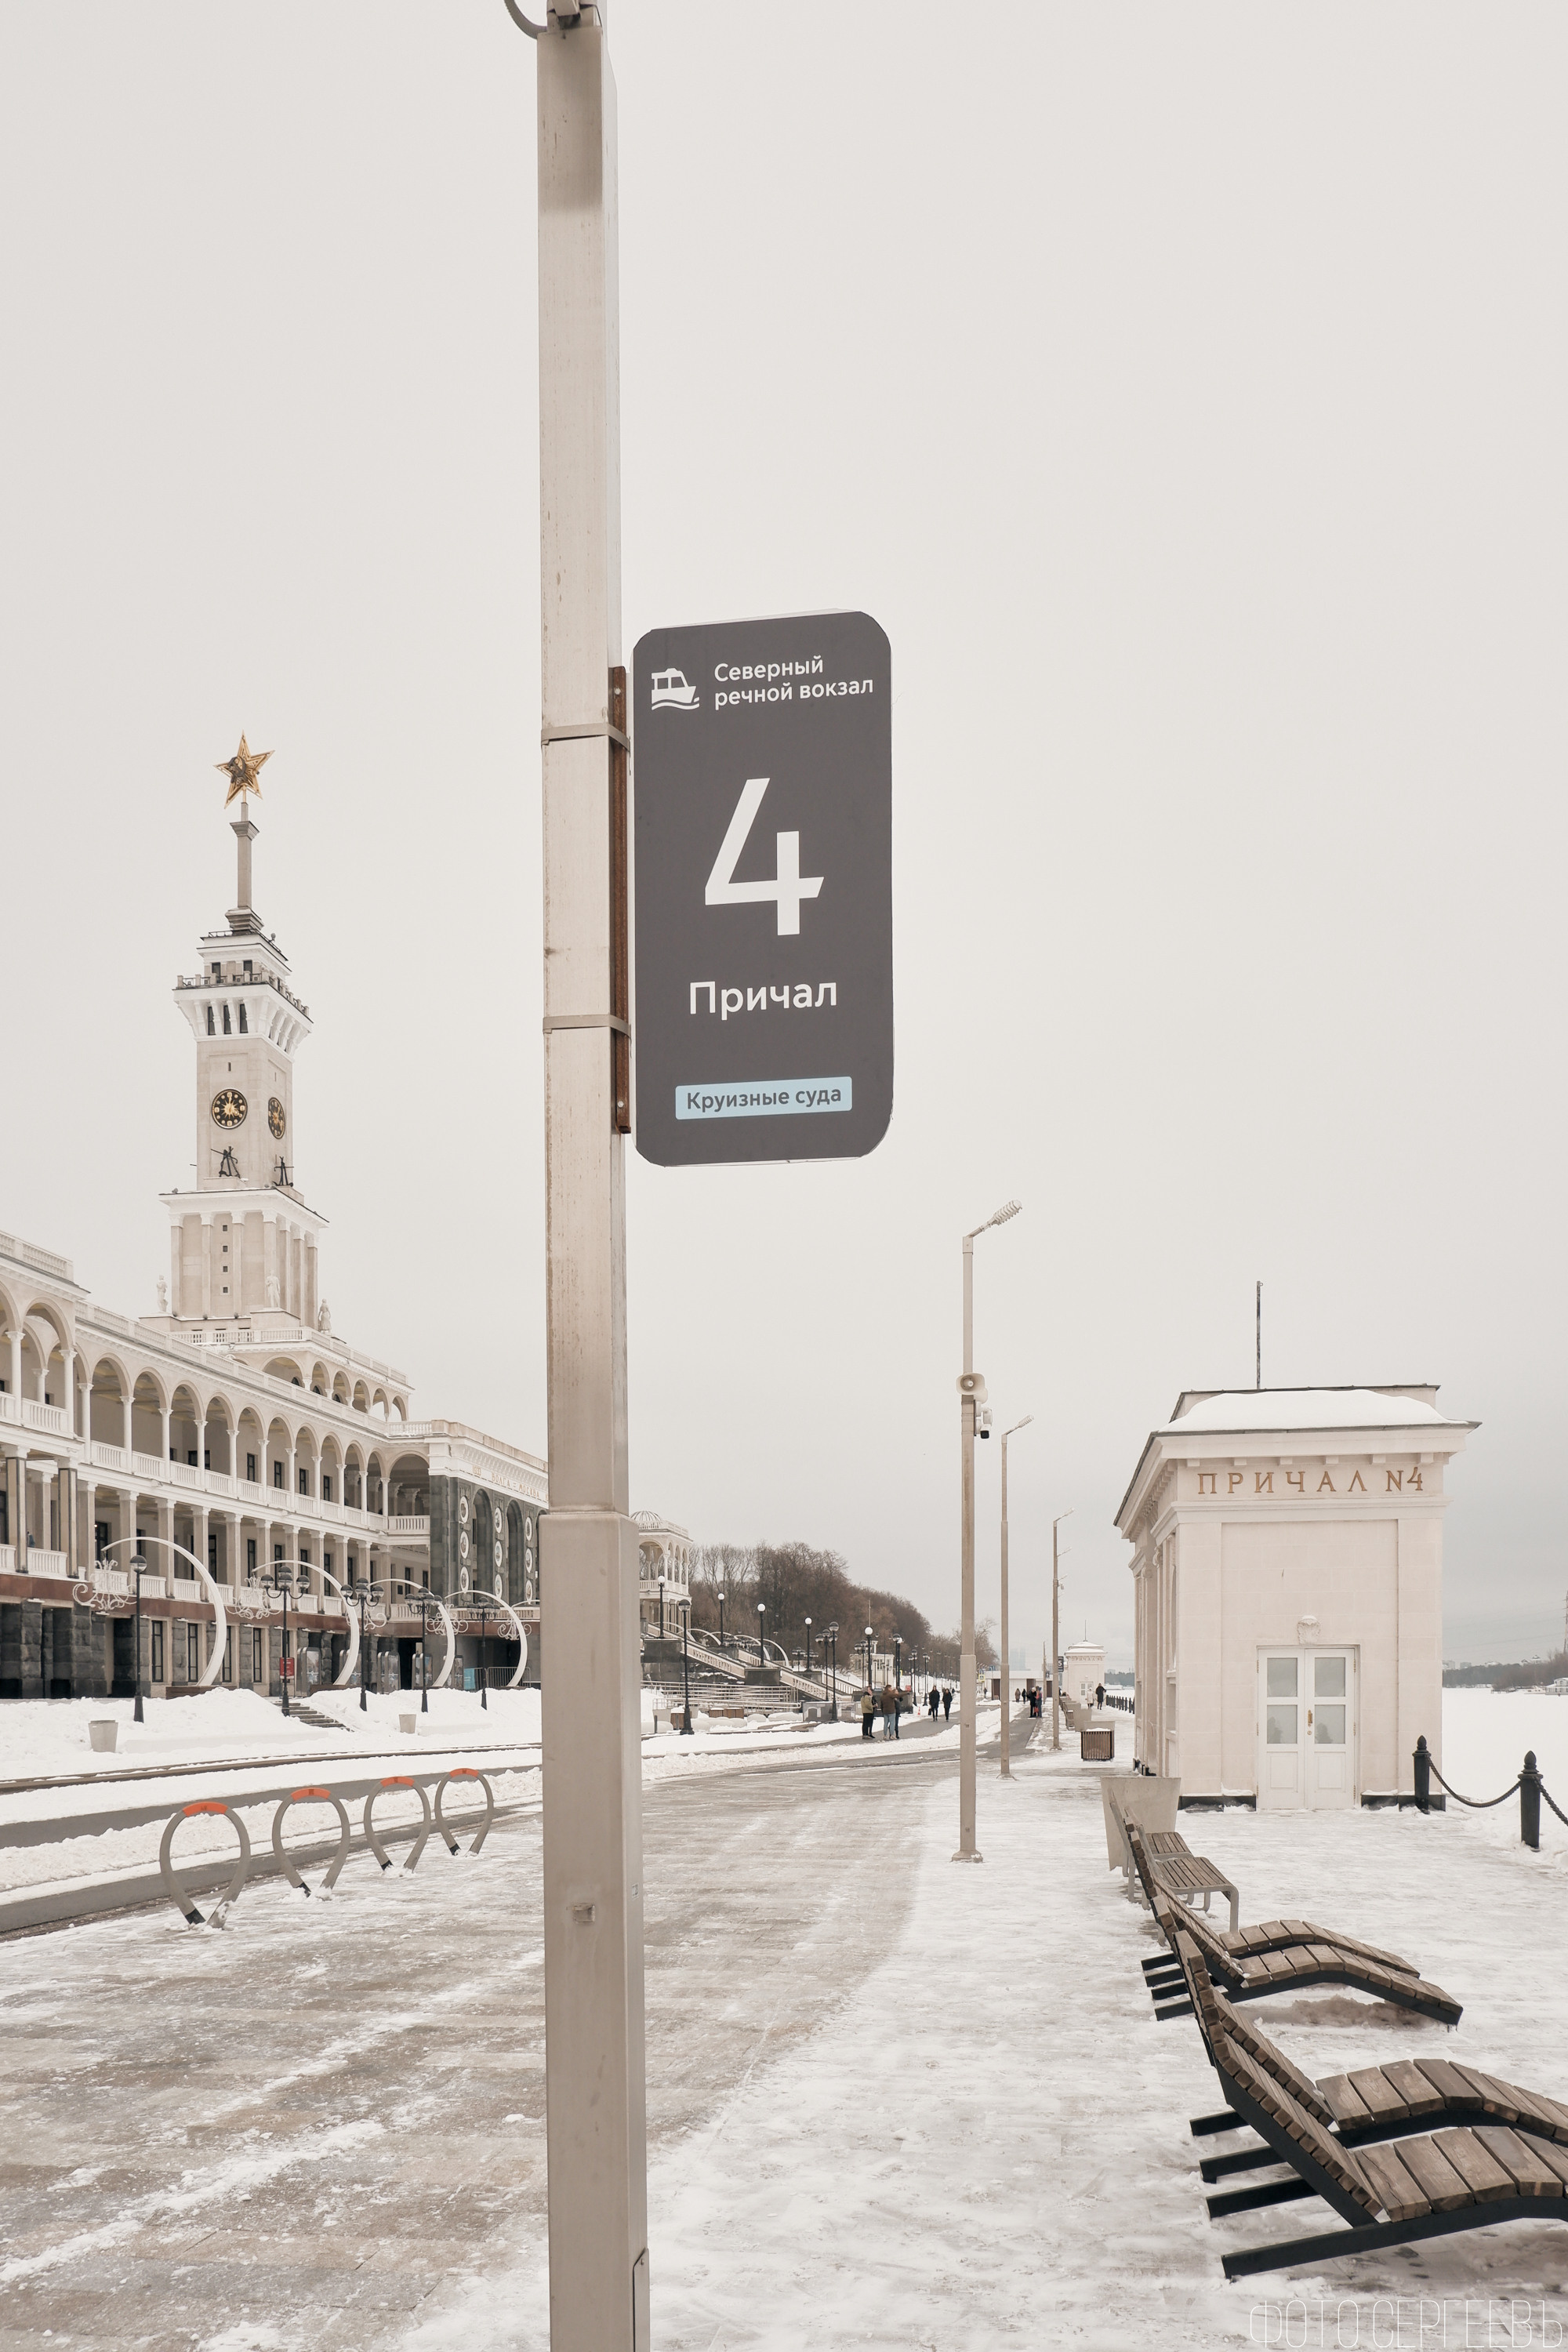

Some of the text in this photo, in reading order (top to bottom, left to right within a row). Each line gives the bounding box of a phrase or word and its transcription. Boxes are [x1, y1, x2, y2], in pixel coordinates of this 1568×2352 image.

[714, 655, 823, 682] Северный
[715, 679, 874, 711] речной вокзал
[705, 777, 825, 936] 4
[690, 982, 837, 1021] Причал
[688, 1089, 842, 1113] Круизные суда
[1197, 1466, 1424, 1494] ПРИЧАЛ N4
